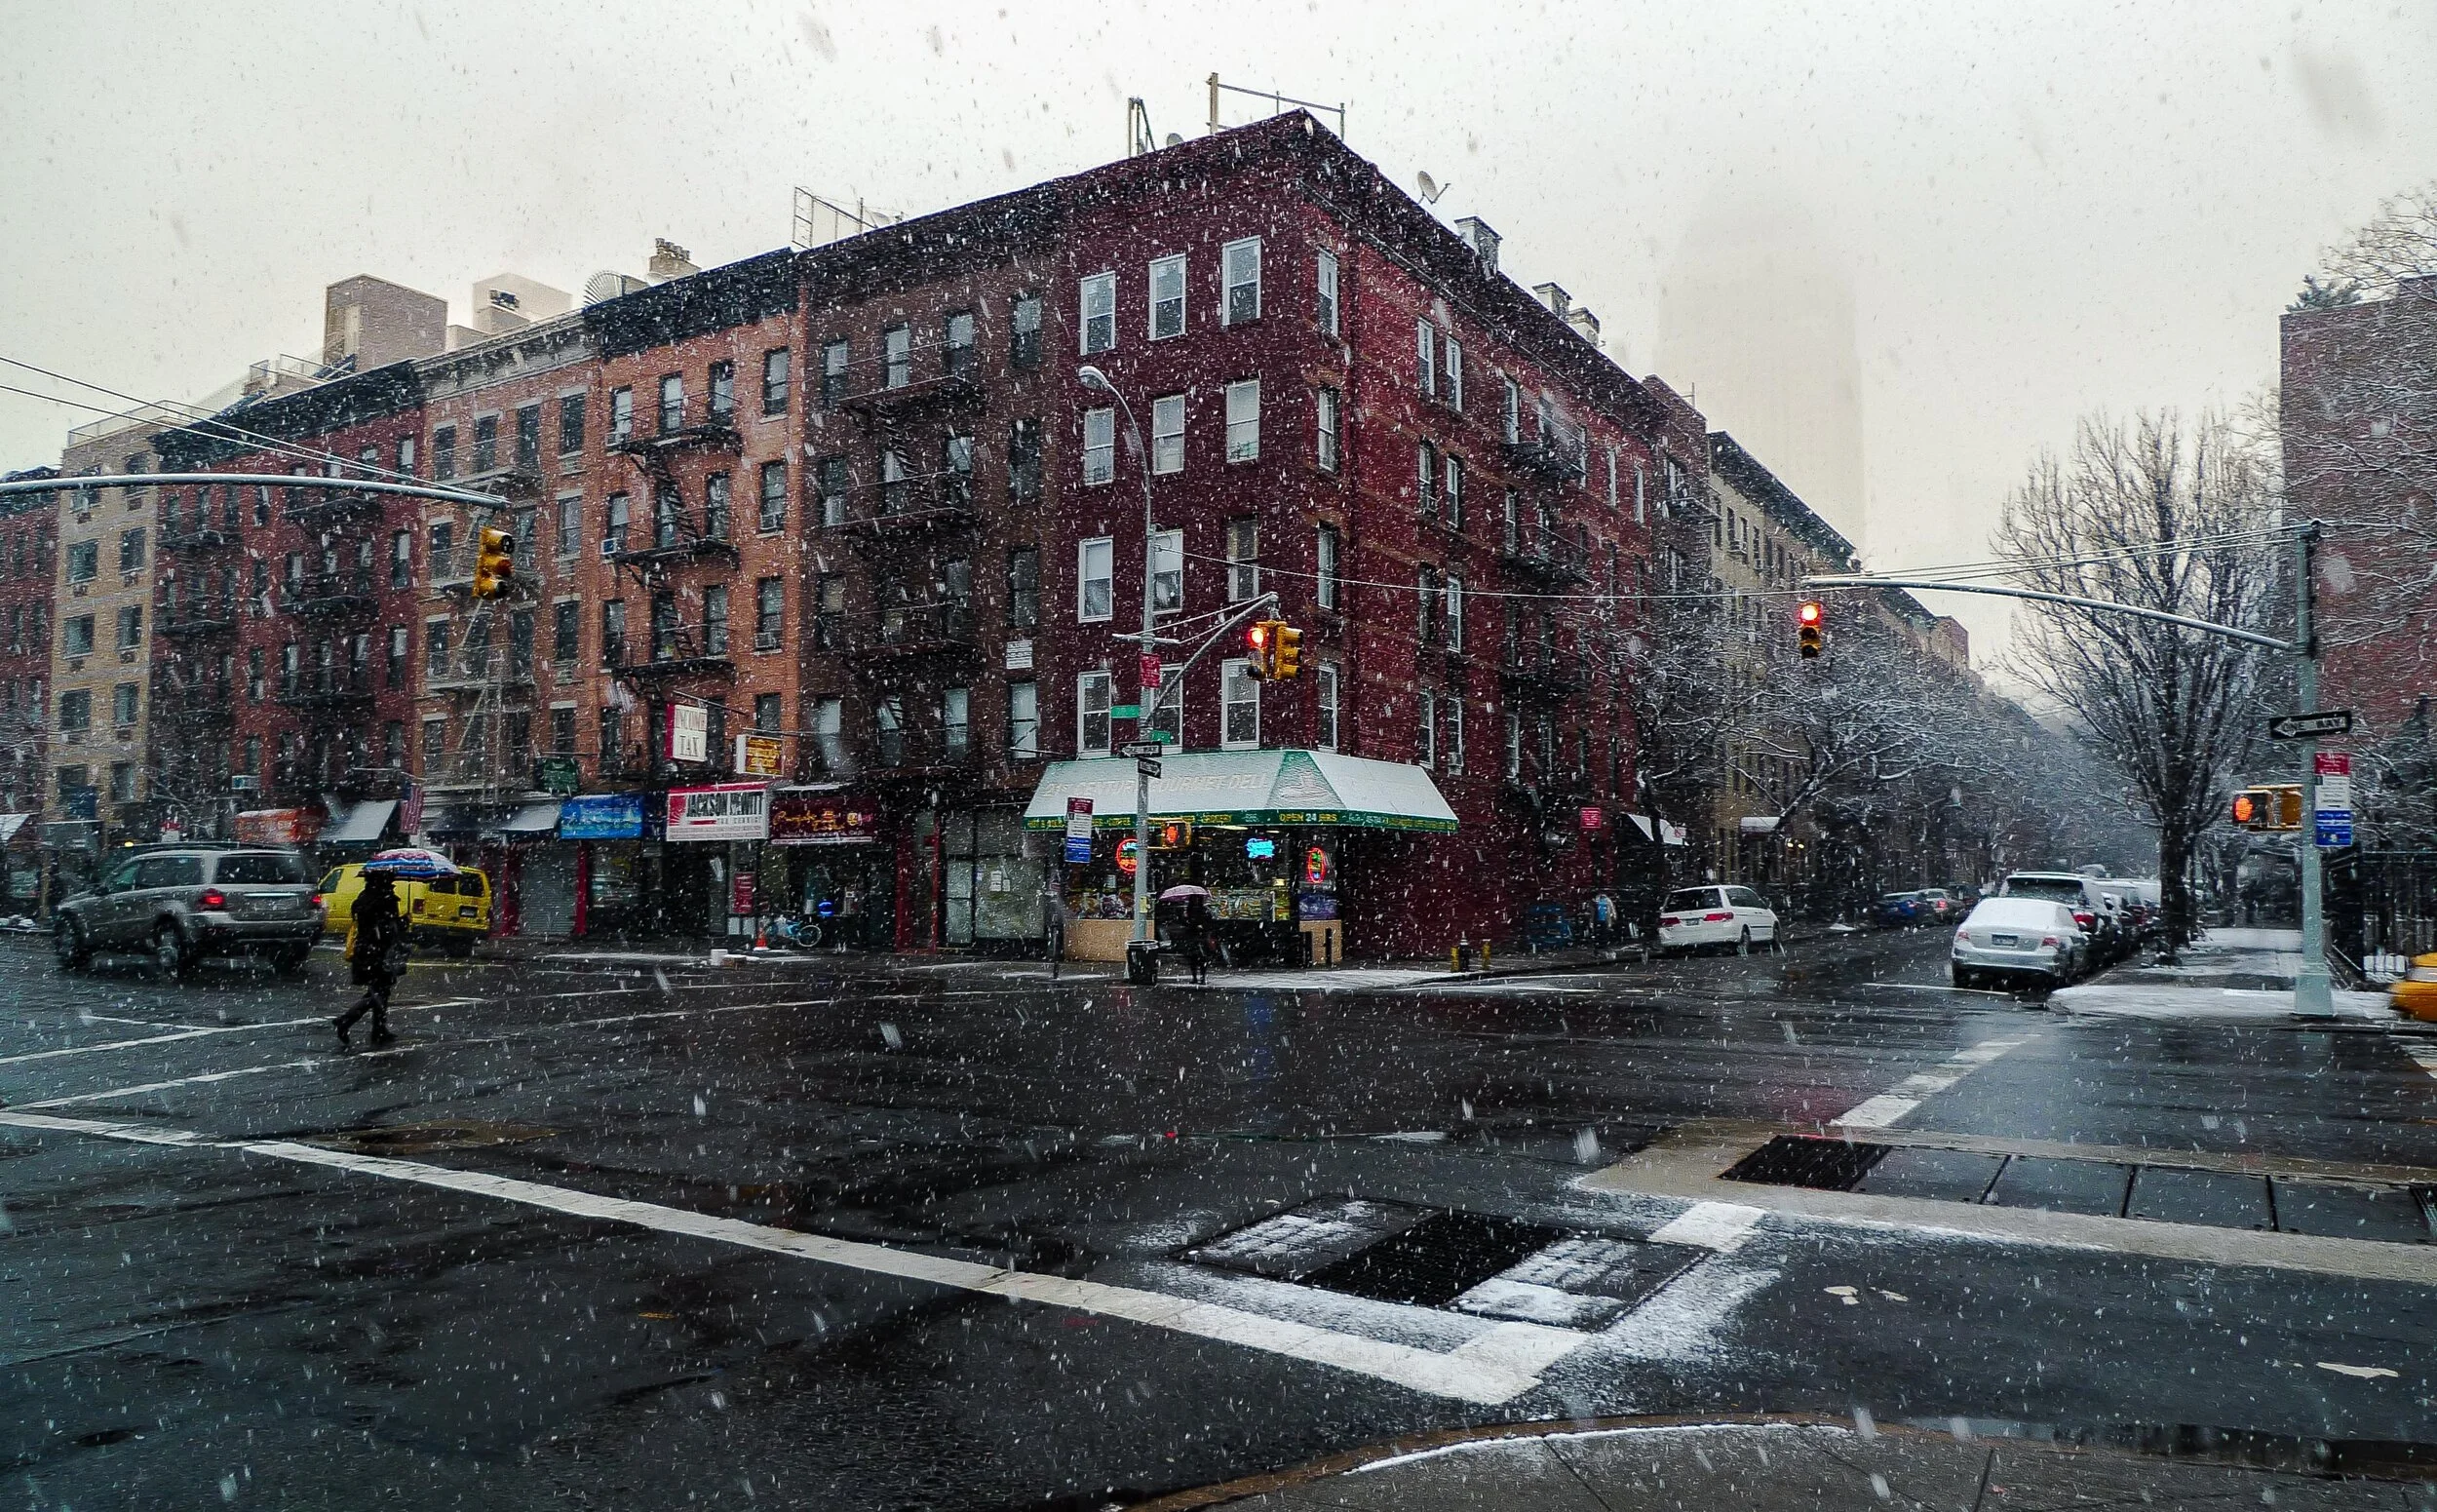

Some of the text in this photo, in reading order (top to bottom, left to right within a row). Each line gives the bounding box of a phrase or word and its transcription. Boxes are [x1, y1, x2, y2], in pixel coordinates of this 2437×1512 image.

[2282, 718, 2342, 731] ONE WAY
[678, 735, 700, 757] TAX
[1227, 773, 1268, 790] DELI
[1278, 813, 1304, 823] OPEN
[1305, 813, 1317, 823] 24
